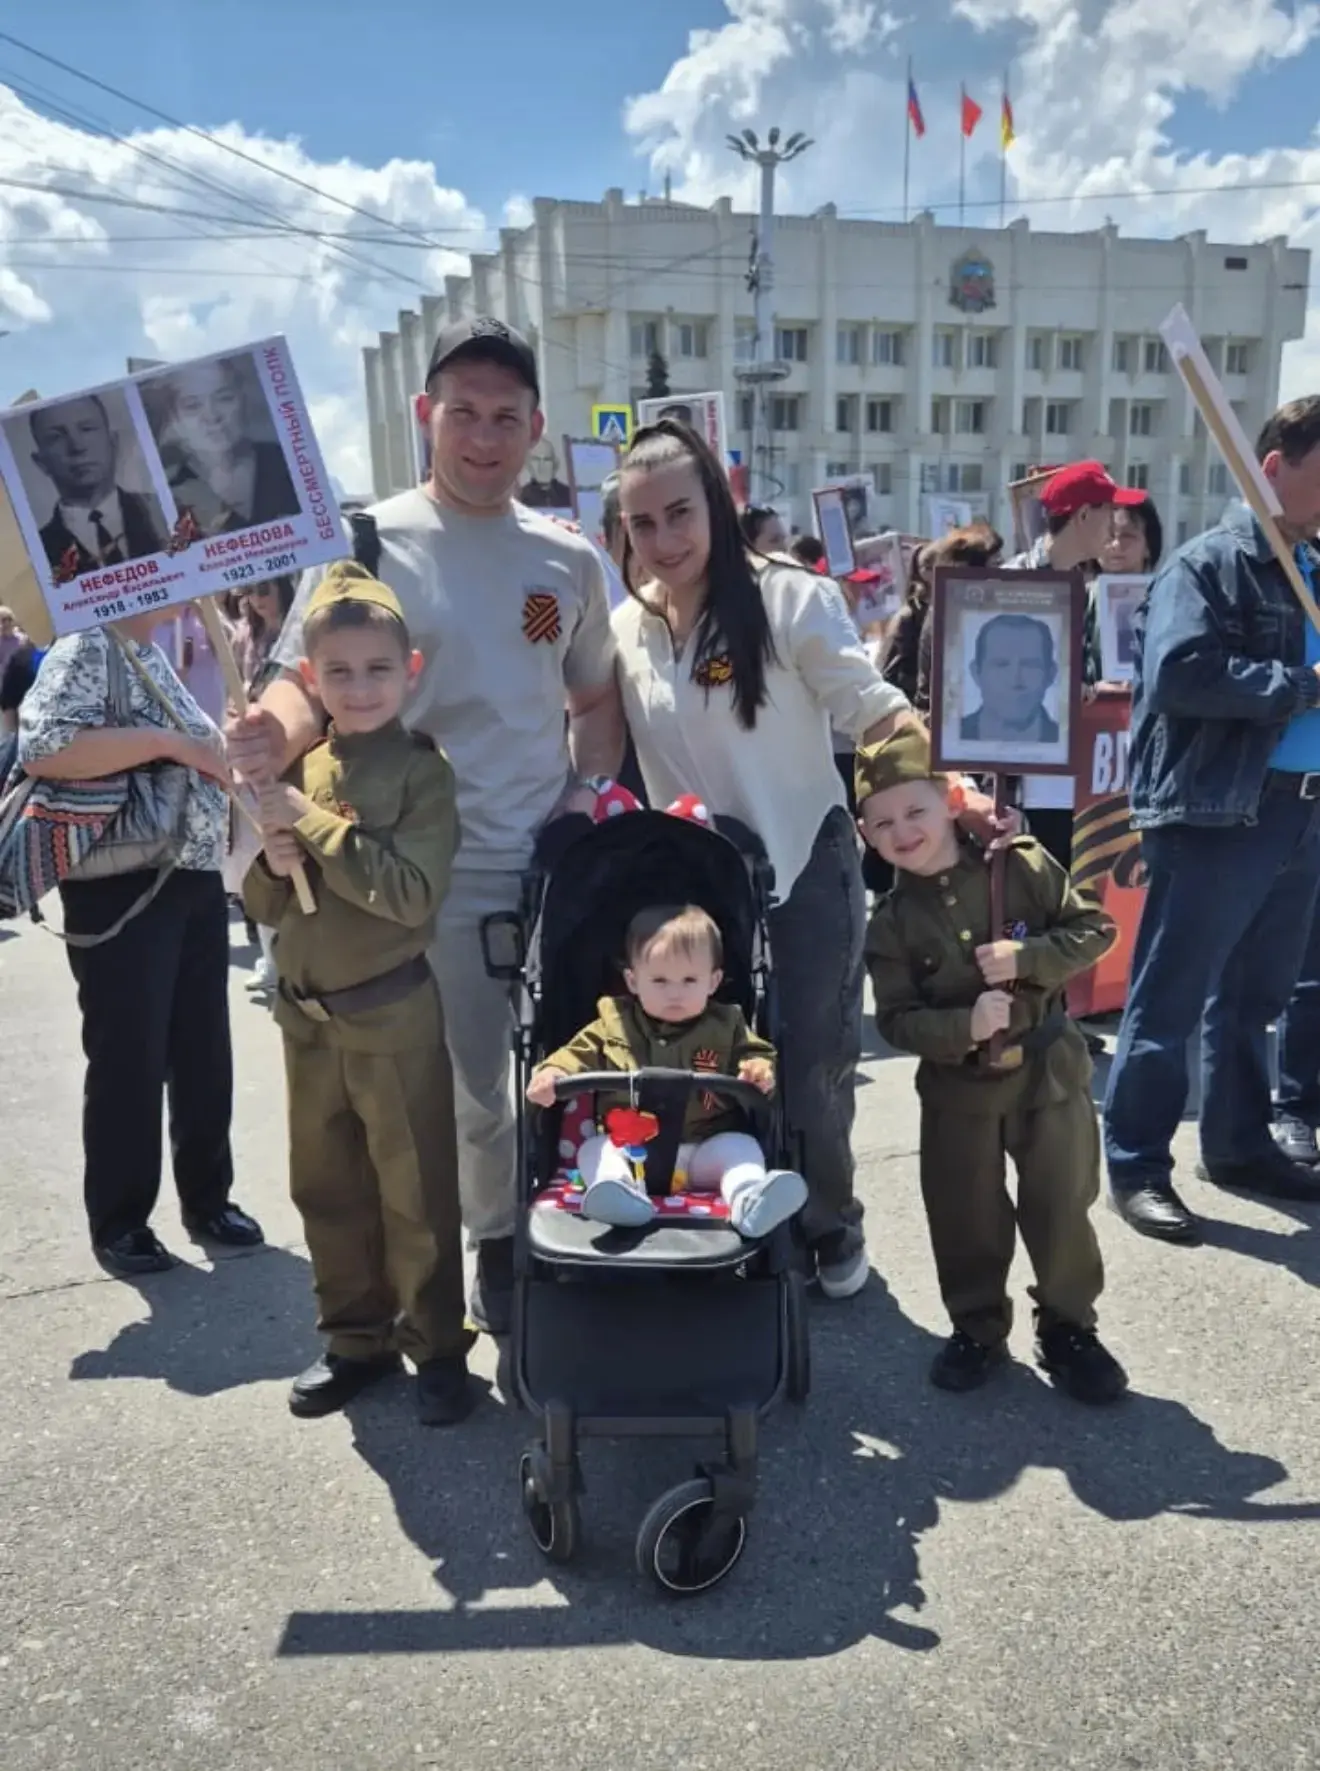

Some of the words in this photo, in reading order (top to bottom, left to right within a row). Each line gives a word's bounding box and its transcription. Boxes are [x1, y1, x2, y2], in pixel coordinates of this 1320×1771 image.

[263, 346, 291, 397] ПОЛК
[279, 402, 335, 540] БЕССМЕРТНЫЙ
[204, 523, 295, 558] НЕФЕДОВА
[80, 559, 159, 593] НЕФЕДОВ
[222, 563, 255, 582] 1923
[264, 551, 297, 572] 2001
[93, 600, 126, 618] 1918
